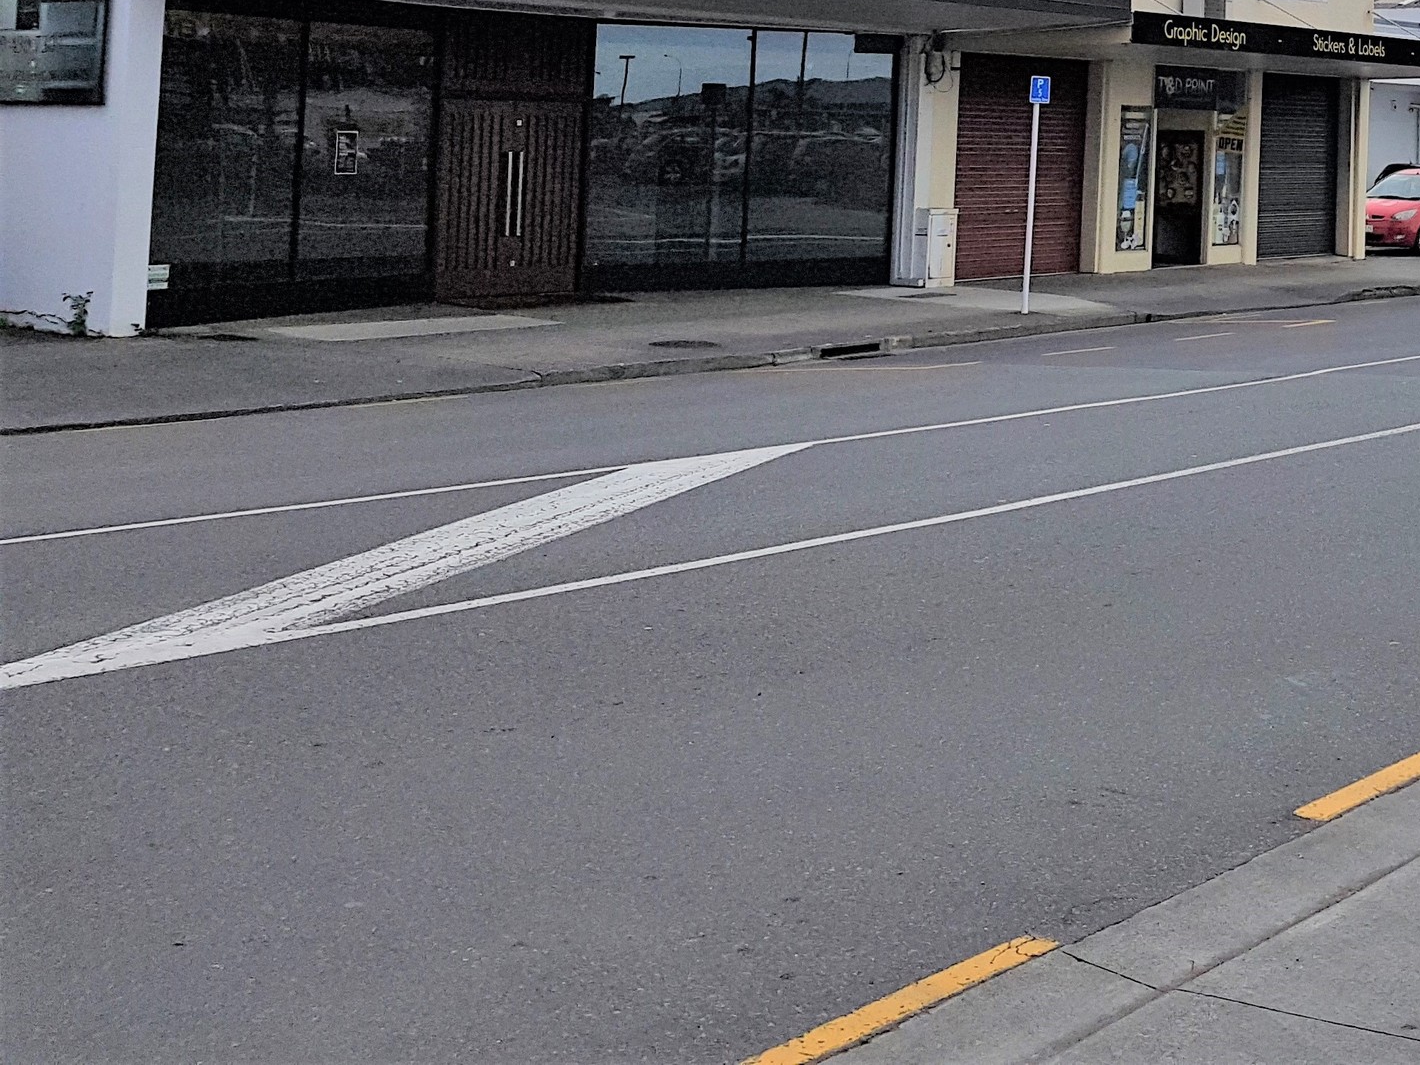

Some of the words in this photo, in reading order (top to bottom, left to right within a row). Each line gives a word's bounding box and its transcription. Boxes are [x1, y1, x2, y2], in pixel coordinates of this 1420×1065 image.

[1164, 19, 1208, 46] Graphic
[1211, 23, 1246, 50] Design
[1312, 34, 1346, 53] Stickers
[1348, 37, 1356, 55] &
[1358, 39, 1386, 57] Labels
[1037, 78, 1044, 89] P
[1185, 78, 1215, 94] PRINT
[1218, 136, 1243, 151] OPEN
